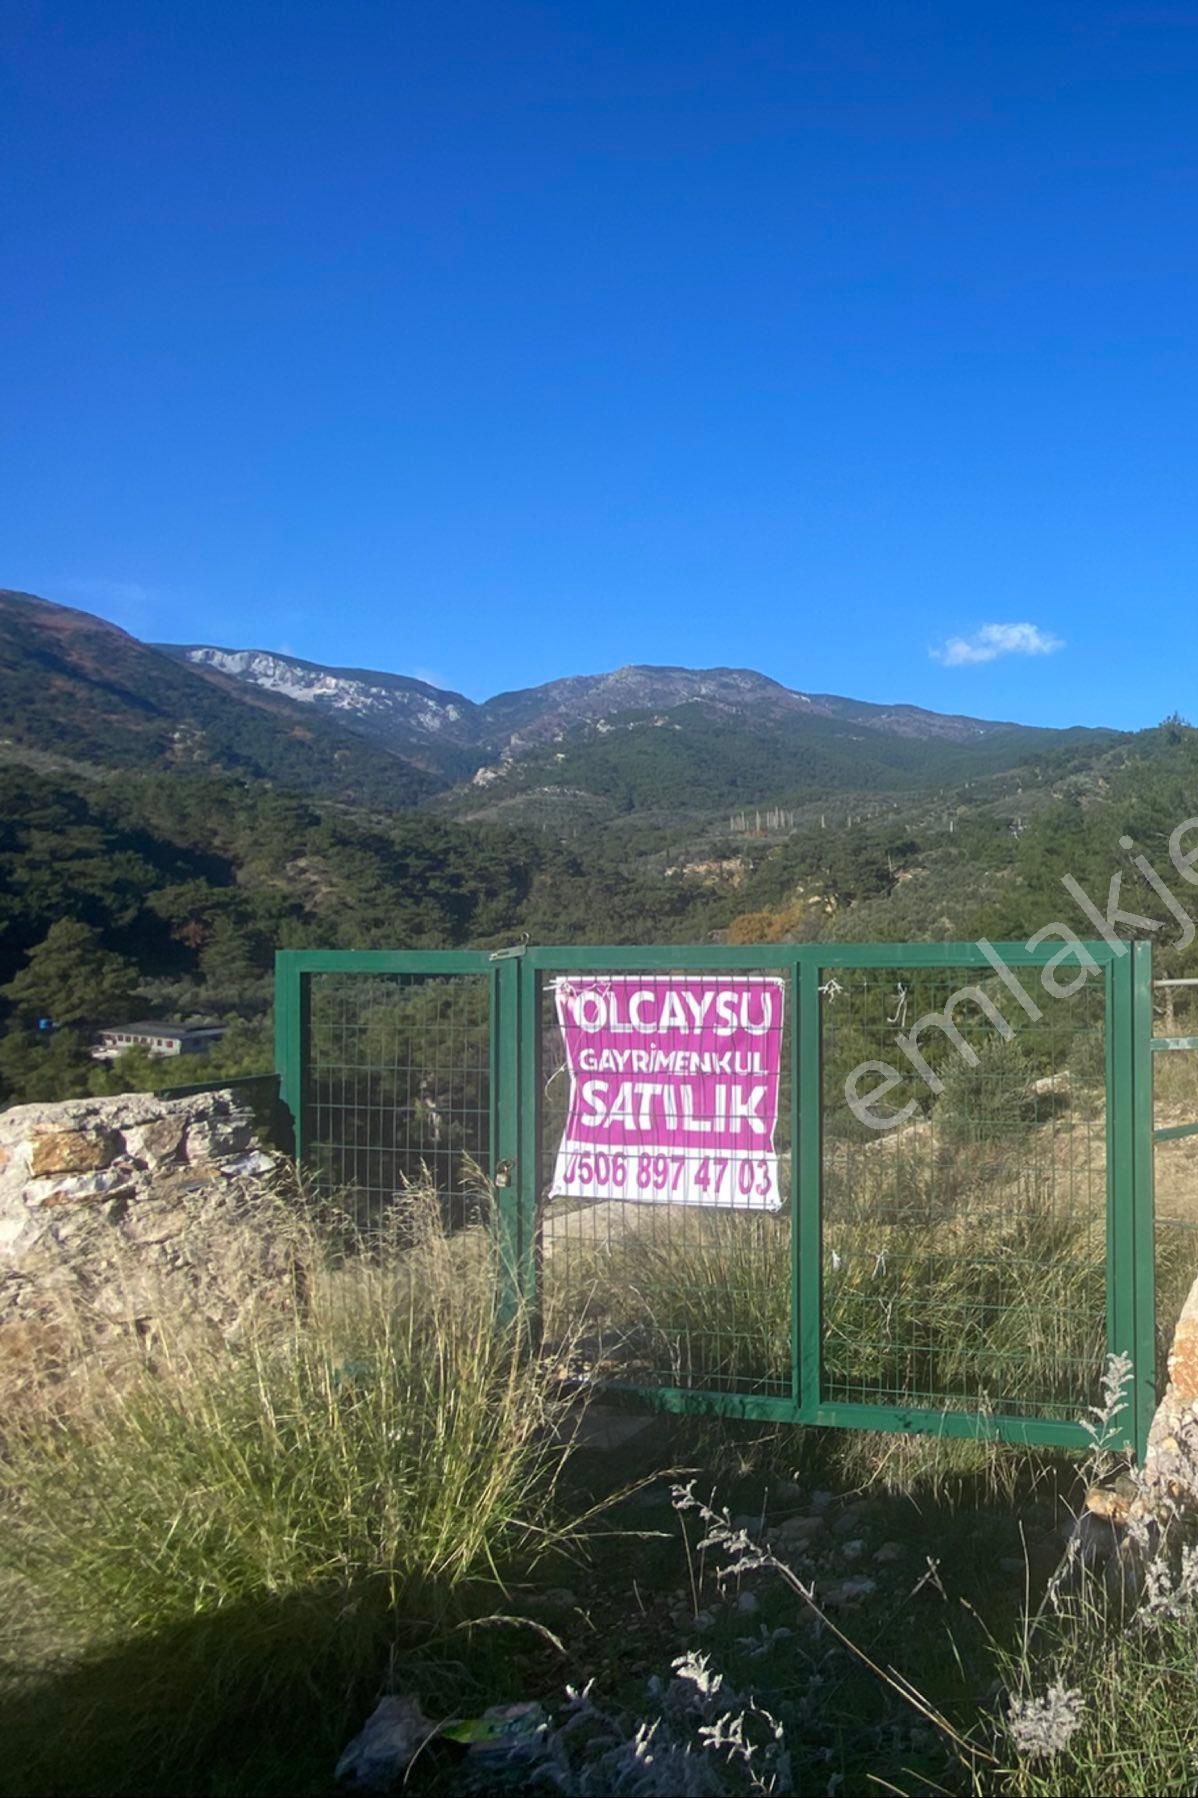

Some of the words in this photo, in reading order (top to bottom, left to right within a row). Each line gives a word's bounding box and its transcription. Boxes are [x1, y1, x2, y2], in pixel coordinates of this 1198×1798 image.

[573, 990, 772, 1036] OLCAYSU
[579, 1042, 769, 1076] GAYRİMENKUL
[580, 1079, 768, 1133] SATILIK
[637, 1152, 685, 1190] 897
[694, 1156, 729, 1193] 47
[738, 1158, 772, 1196] 03
